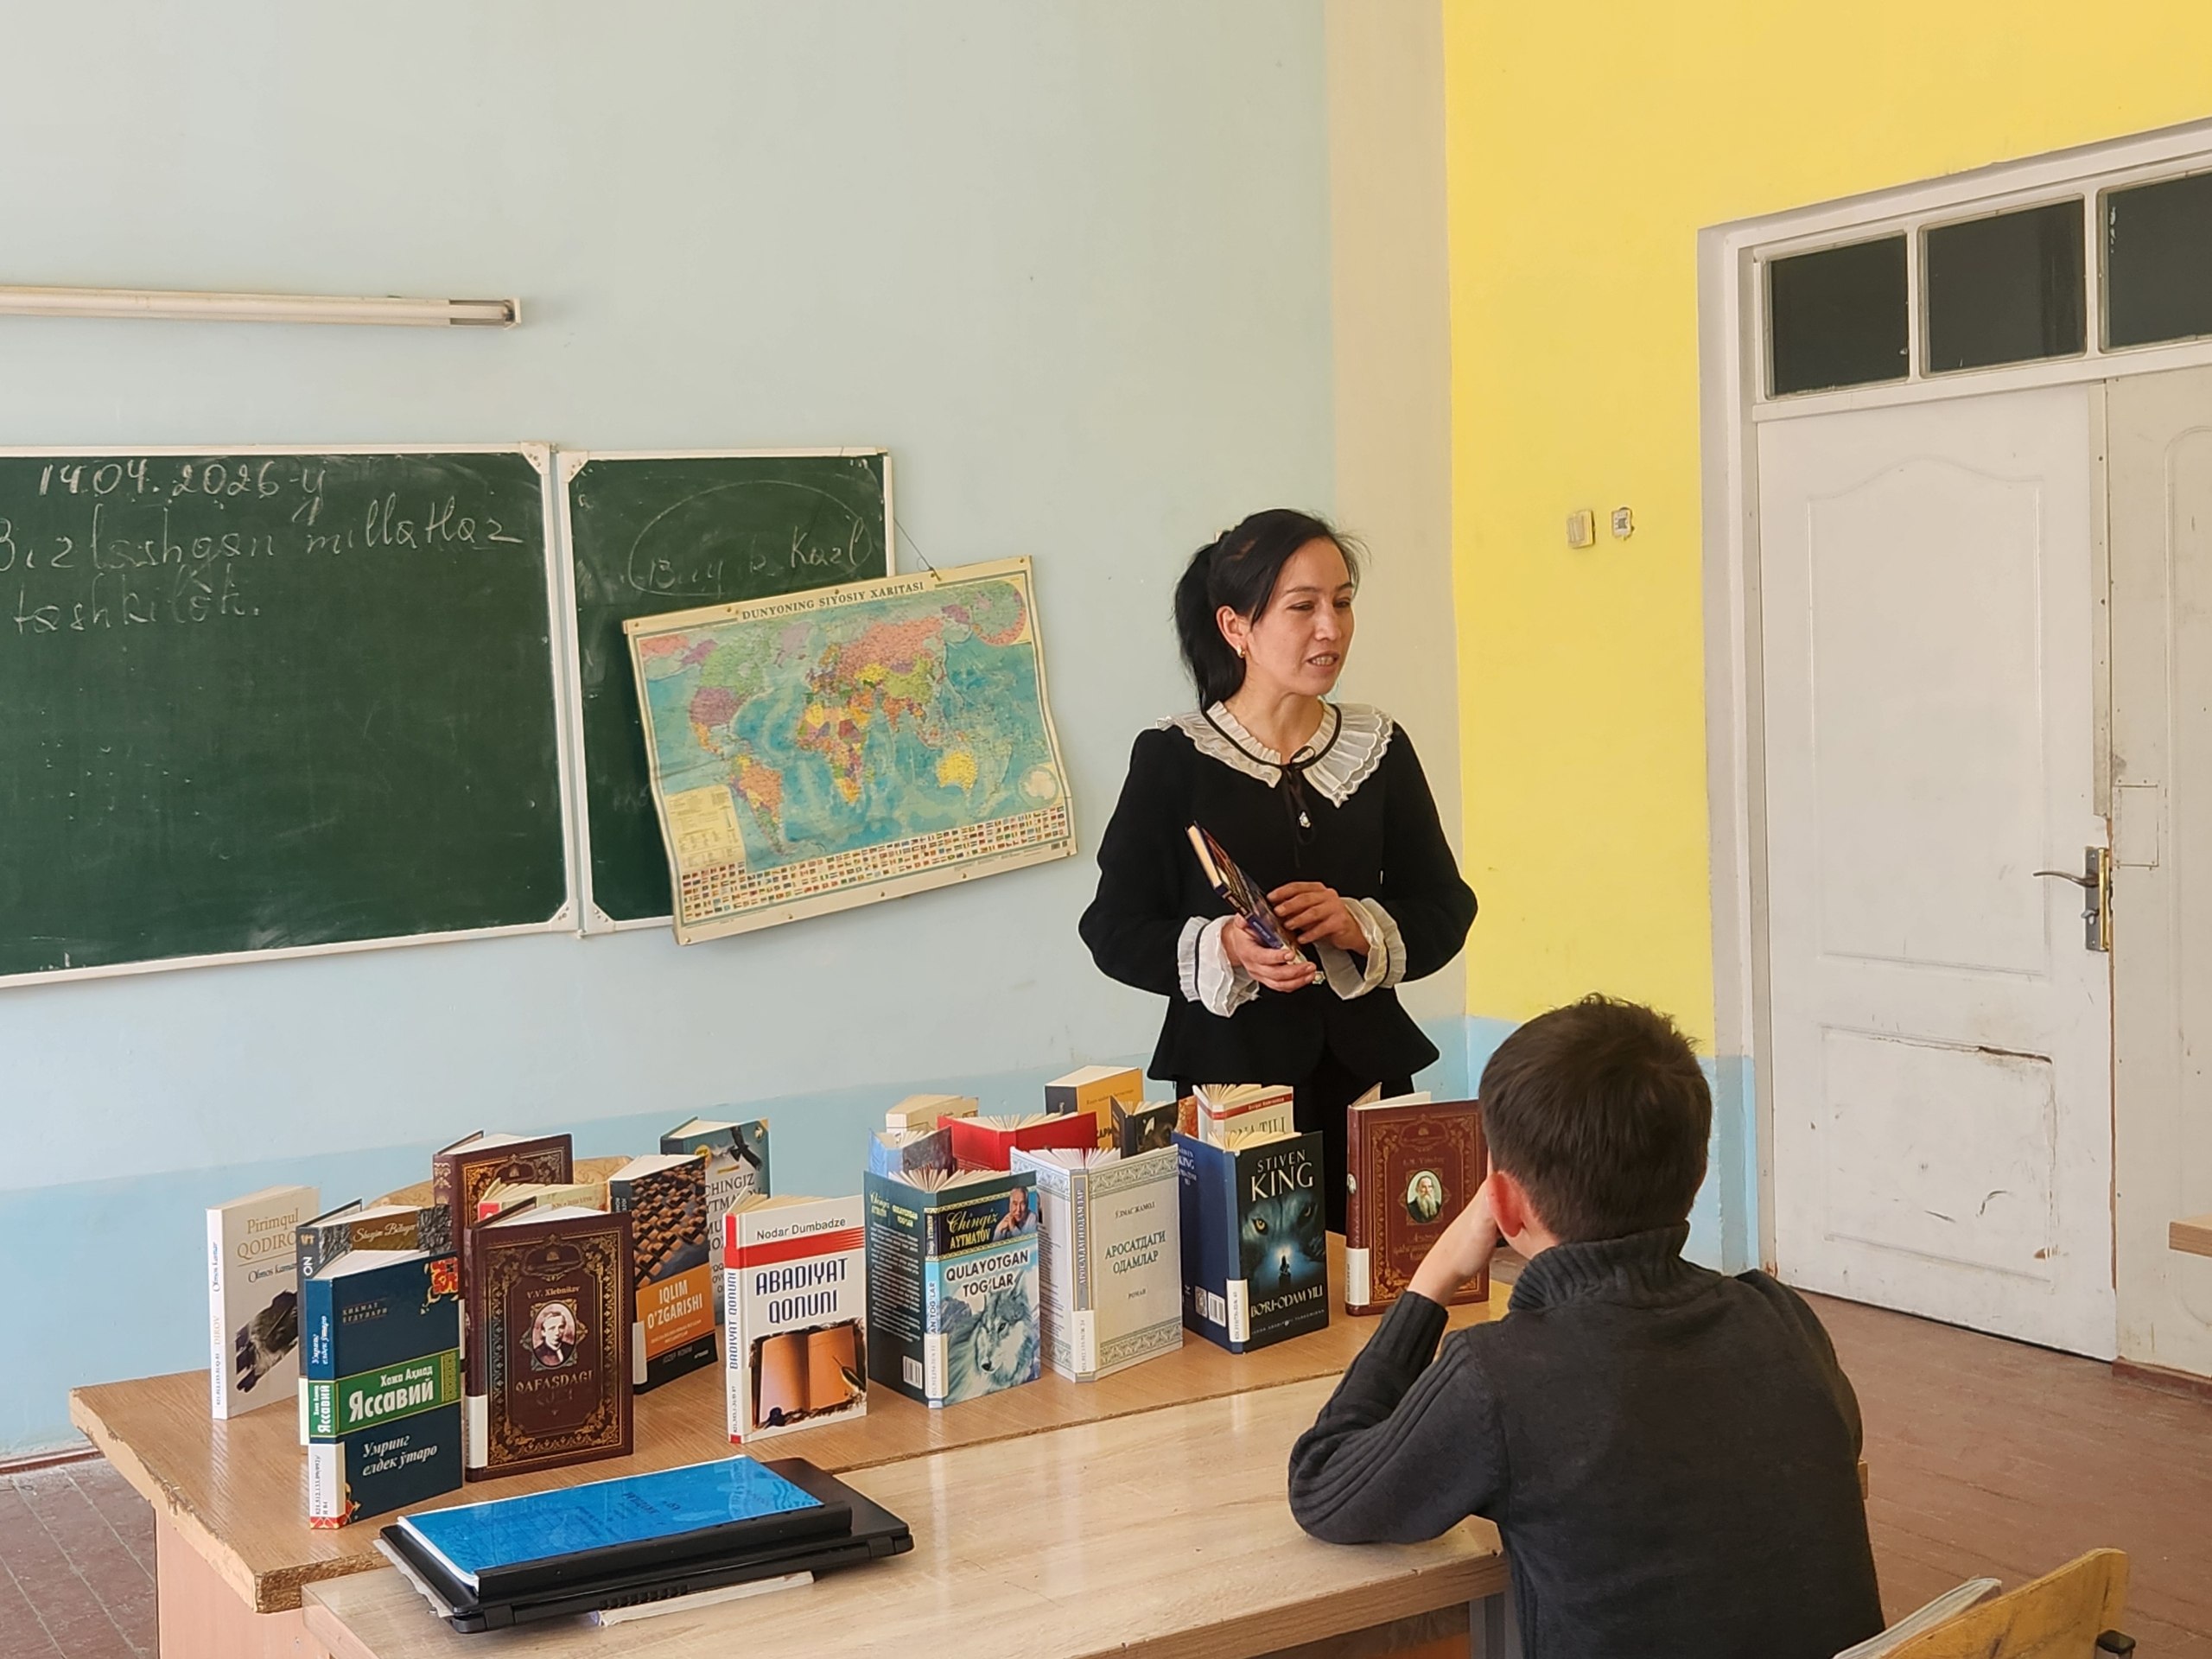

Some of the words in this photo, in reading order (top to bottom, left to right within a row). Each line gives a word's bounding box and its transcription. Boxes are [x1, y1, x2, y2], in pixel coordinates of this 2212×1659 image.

[742, 600, 815, 620] DUNYONING
[819, 591, 865, 607] SIYOSIY
[870, 582, 925, 599] XARITASI
[1257, 1149, 1306, 1173] STIVEN
[704, 1173, 754, 1198] CHINGIZ
[1251, 1162, 1313, 1202] KING
[247, 1208, 298, 1234] Pirimqul
[757, 1227, 789, 1240] Nodar
[791, 1217, 846, 1235] Dumbadze
[946, 1207, 999, 1234] Chingiz
[237, 1230, 297, 1261] QODIRO
[950, 1228, 991, 1249] AYTMATOV
[1105, 1230, 1166, 1260] АРОСАТДАГИ
[275, 1262, 297, 1274] kama
[756, 1257, 848, 1296] ABADIYAT
[946, 1249, 1028, 1281] QULAYOTGAN
[1113, 1249, 1159, 1274] ОДАМЛАР
[659, 1279, 688, 1305] IQLIM
[728, 1272, 737, 1316] QONUNI
[963, 1273, 1014, 1297] TOG'LAR
[647, 1293, 702, 1329] O'ZGARISHI
[769, 1289, 837, 1324] QONUNI
[213, 1315, 221, 1345] DIROV
[728, 1319, 739, 1370] BADIYAT
[380, 1374, 404, 1388] Хожа
[405, 1366, 433, 1381] Аҳмад
[515, 1370, 594, 1393] QAFASDAGI
[317, 1384, 331, 1433] Яссавий
[349, 1377, 434, 1423] Яссавий
[362, 1457, 397, 1476] елдек
[398, 1446, 437, 1470] ўтаро
[363, 1435, 410, 1458] Умринг
